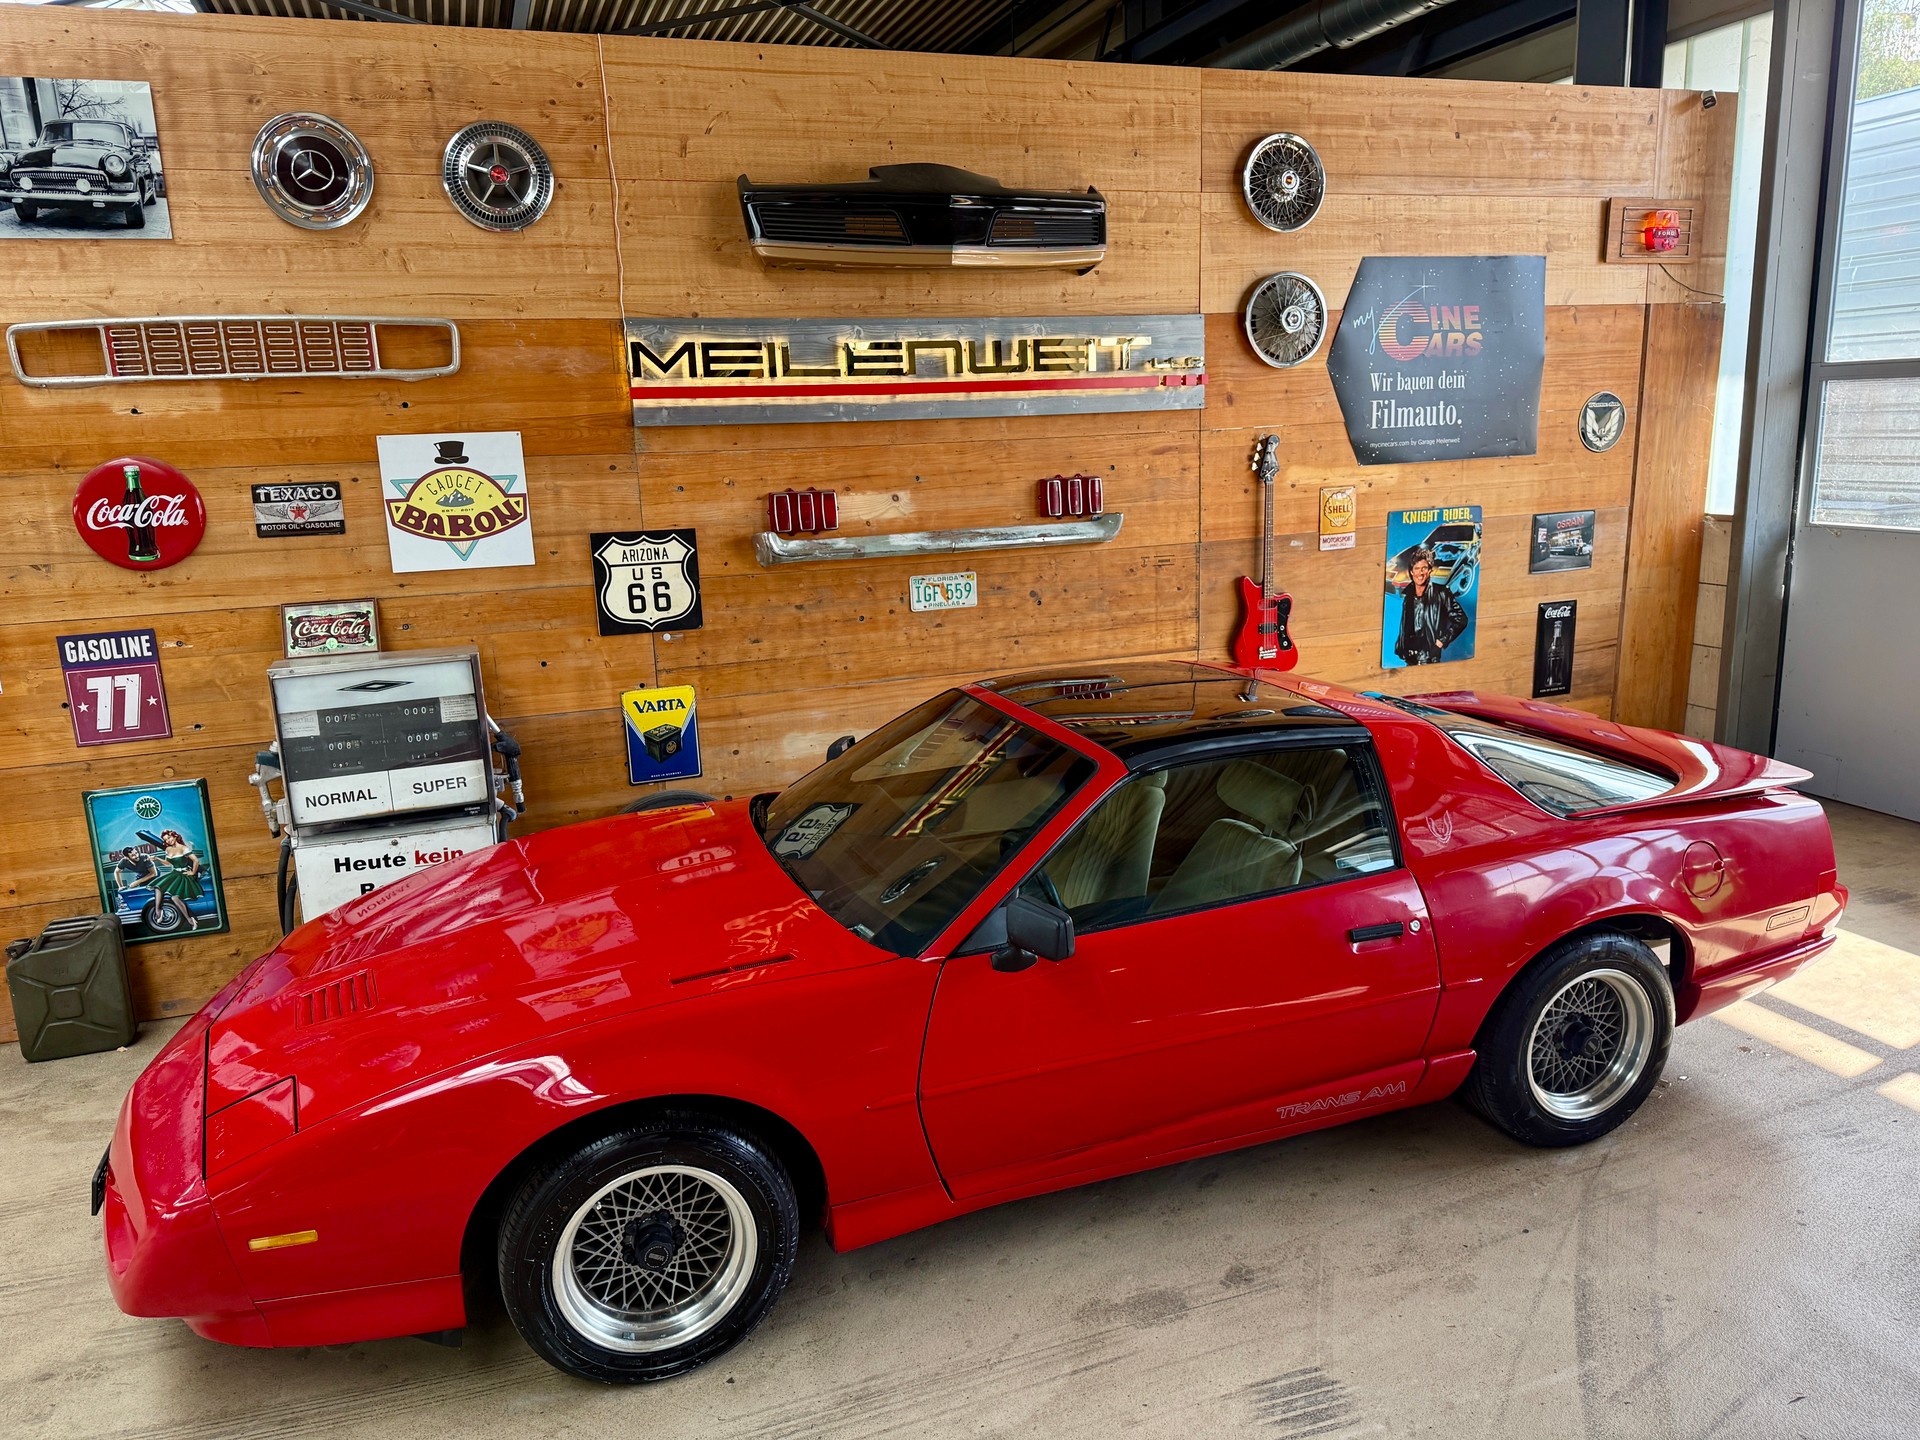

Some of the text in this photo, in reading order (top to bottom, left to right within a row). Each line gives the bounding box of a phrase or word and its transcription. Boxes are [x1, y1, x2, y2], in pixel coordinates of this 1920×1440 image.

[1370, 370, 1466, 392] Wir bauen dein
[1370, 399, 1463, 429] Filmauto.
[256, 486, 337, 502] TEXACO
[426, 474, 485, 496] GADGET
[86, 494, 187, 531] Coca-Cola
[397, 499, 522, 537] BARON
[1328, 504, 1351, 514] SHELL
[1402, 510, 1440, 524] KNIGHT
[261, 523, 287, 531] MOTOR
[305, 521, 341, 529] GASOLINE
[1557, 515, 1585, 529] OSRAM
[621, 547, 669, 563] ARIZONA
[627, 581, 672, 614] 66
[295, 617, 368, 638] Coca-Cola
[64, 635, 153, 663] GASOLINE
[633, 699, 686, 714] VARTA
[412, 776, 468, 795] SUPER
[305, 788, 378, 808] NORMAL
[334, 847, 464, 873] Heute kein
[1276, 1080, 1406, 1119] TRANS AM
